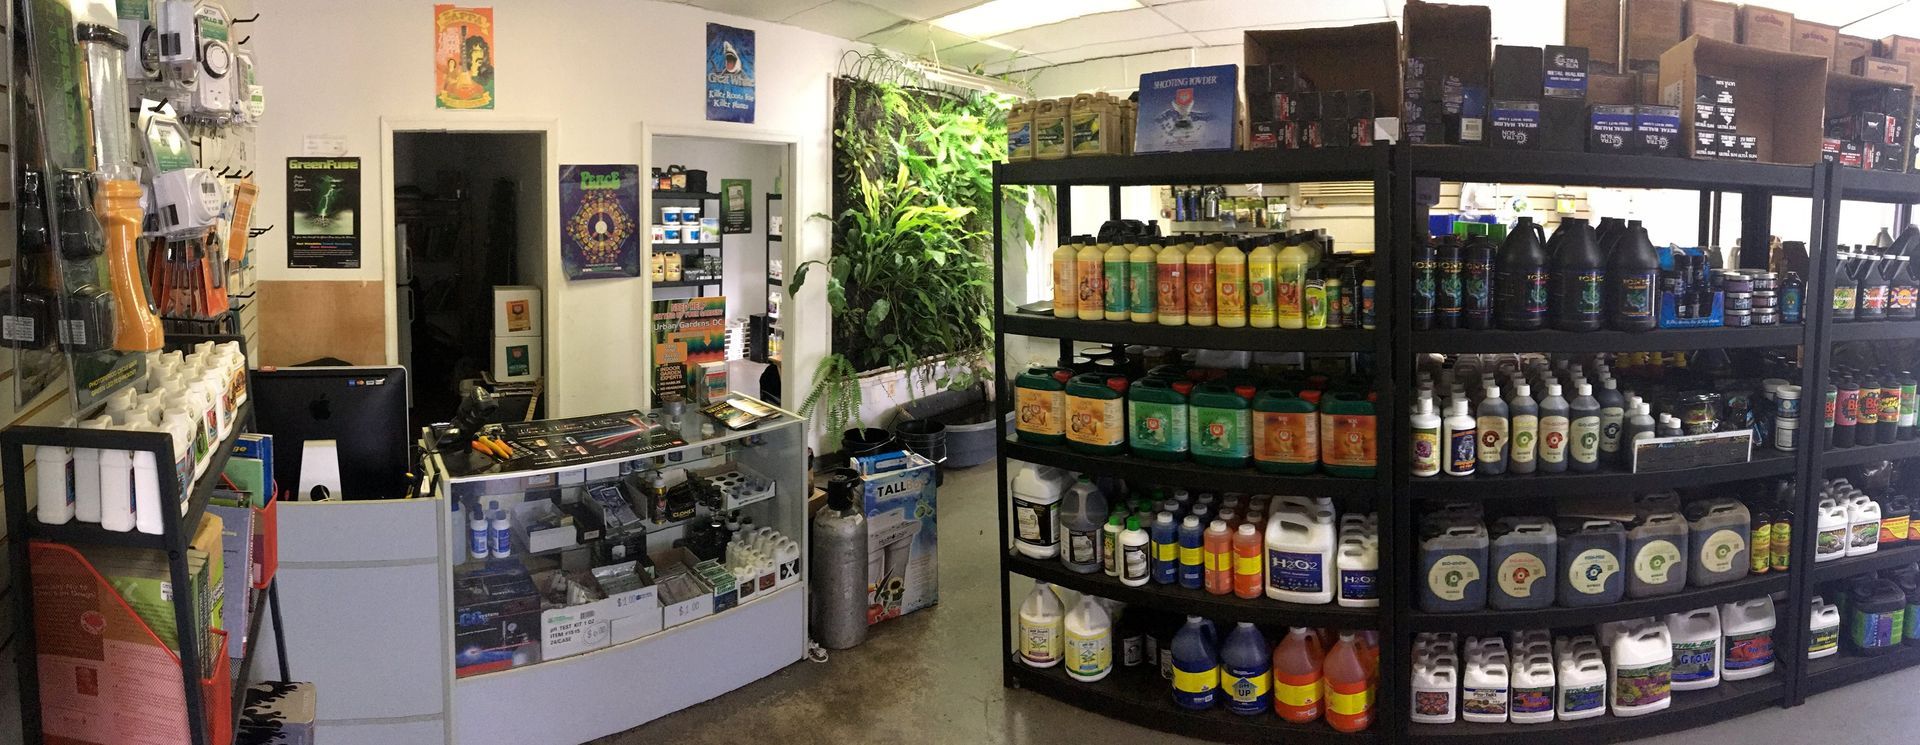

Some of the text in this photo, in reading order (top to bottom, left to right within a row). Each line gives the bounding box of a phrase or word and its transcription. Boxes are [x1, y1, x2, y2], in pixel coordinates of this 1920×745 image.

[709, 89, 727, 98] Killer
[713, 99, 731, 108] Killer
[289, 159, 359, 170] GreenFuse
[580, 171, 621, 190] PEACE
[653, 318, 723, 331] Urban Gardens DC
[672, 508, 696, 518] CLONEX
[559, 623, 572, 631] TEST
[550, 631, 564, 639] ITEM
[1679, 652, 1712, 665] Grow
[1238, 689, 1251, 697] UP
